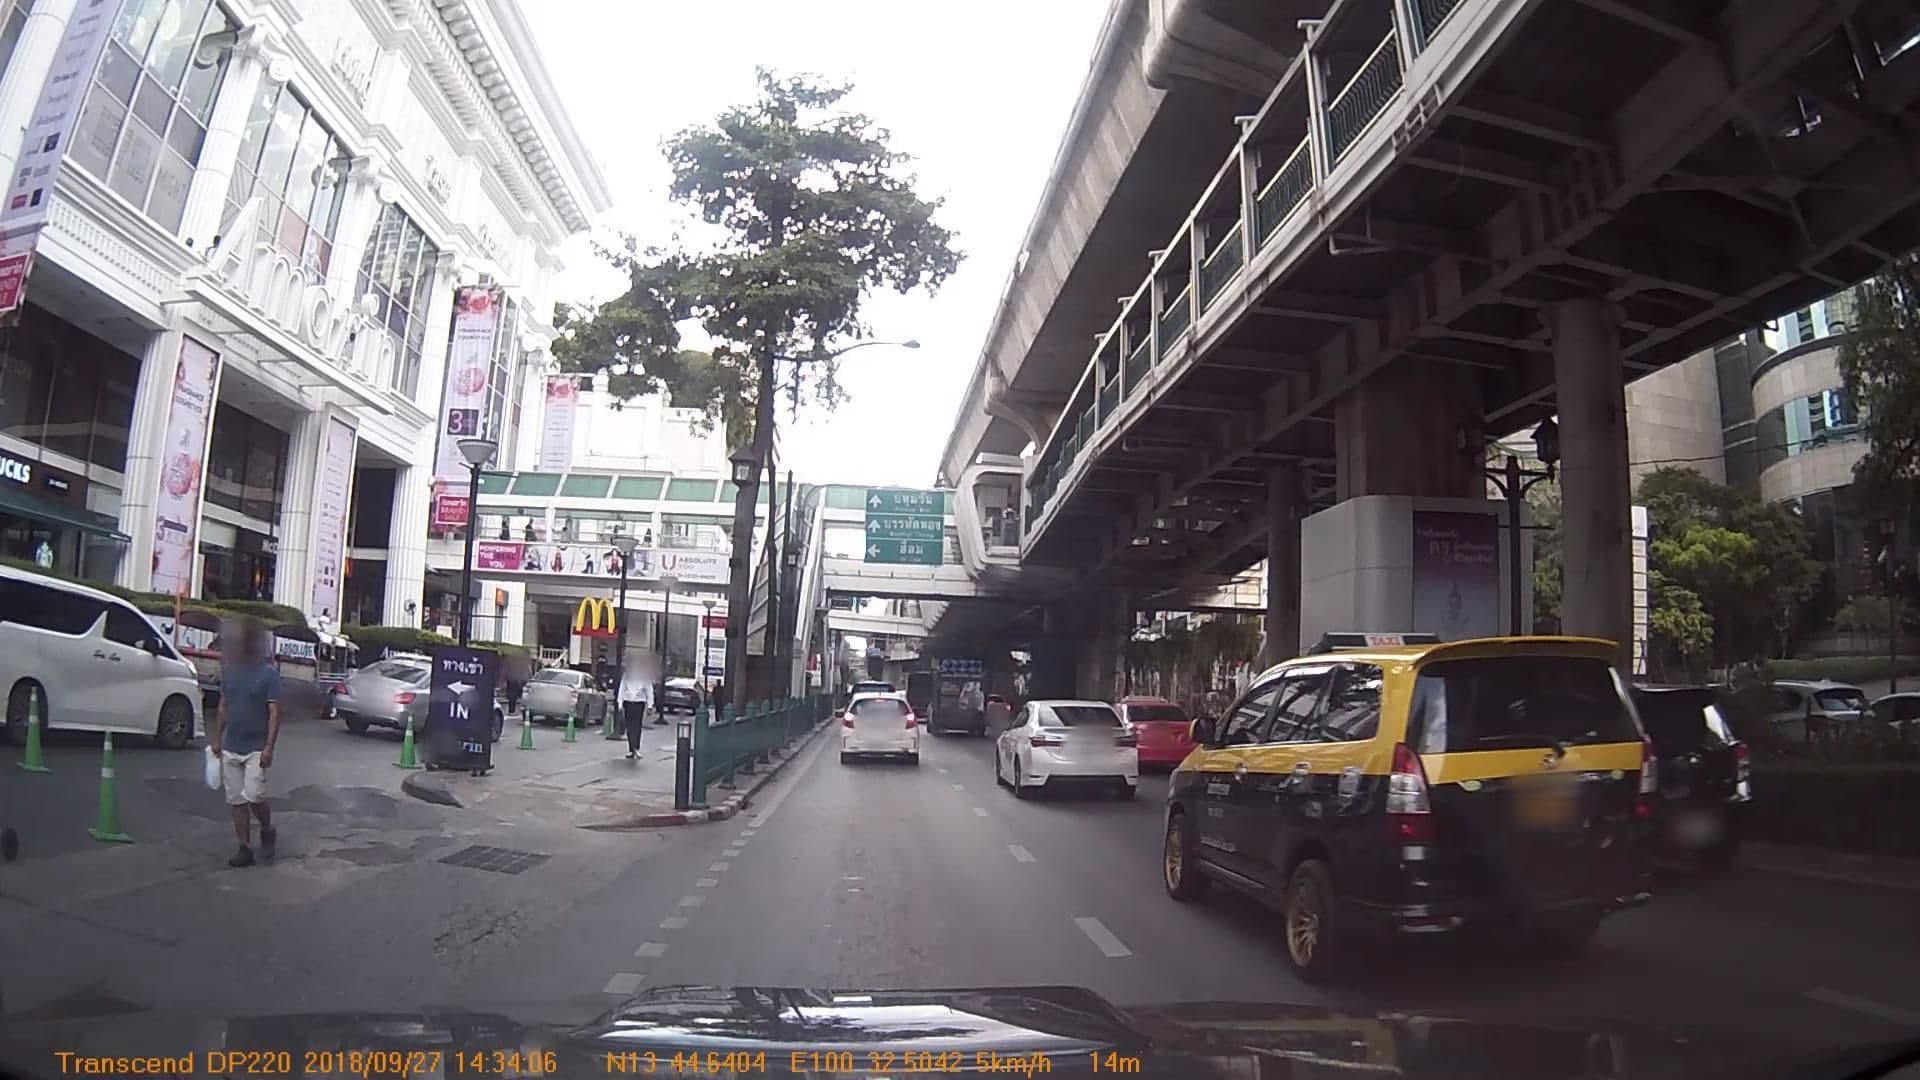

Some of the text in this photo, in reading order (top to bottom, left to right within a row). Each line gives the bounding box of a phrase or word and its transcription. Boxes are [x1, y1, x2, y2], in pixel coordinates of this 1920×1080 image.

[448, 410, 464, 434] 3
[1369, 636, 1400, 646] TAXI
[443, 656, 483, 674] ทางเข้า
[449, 702, 469, 720] IN
